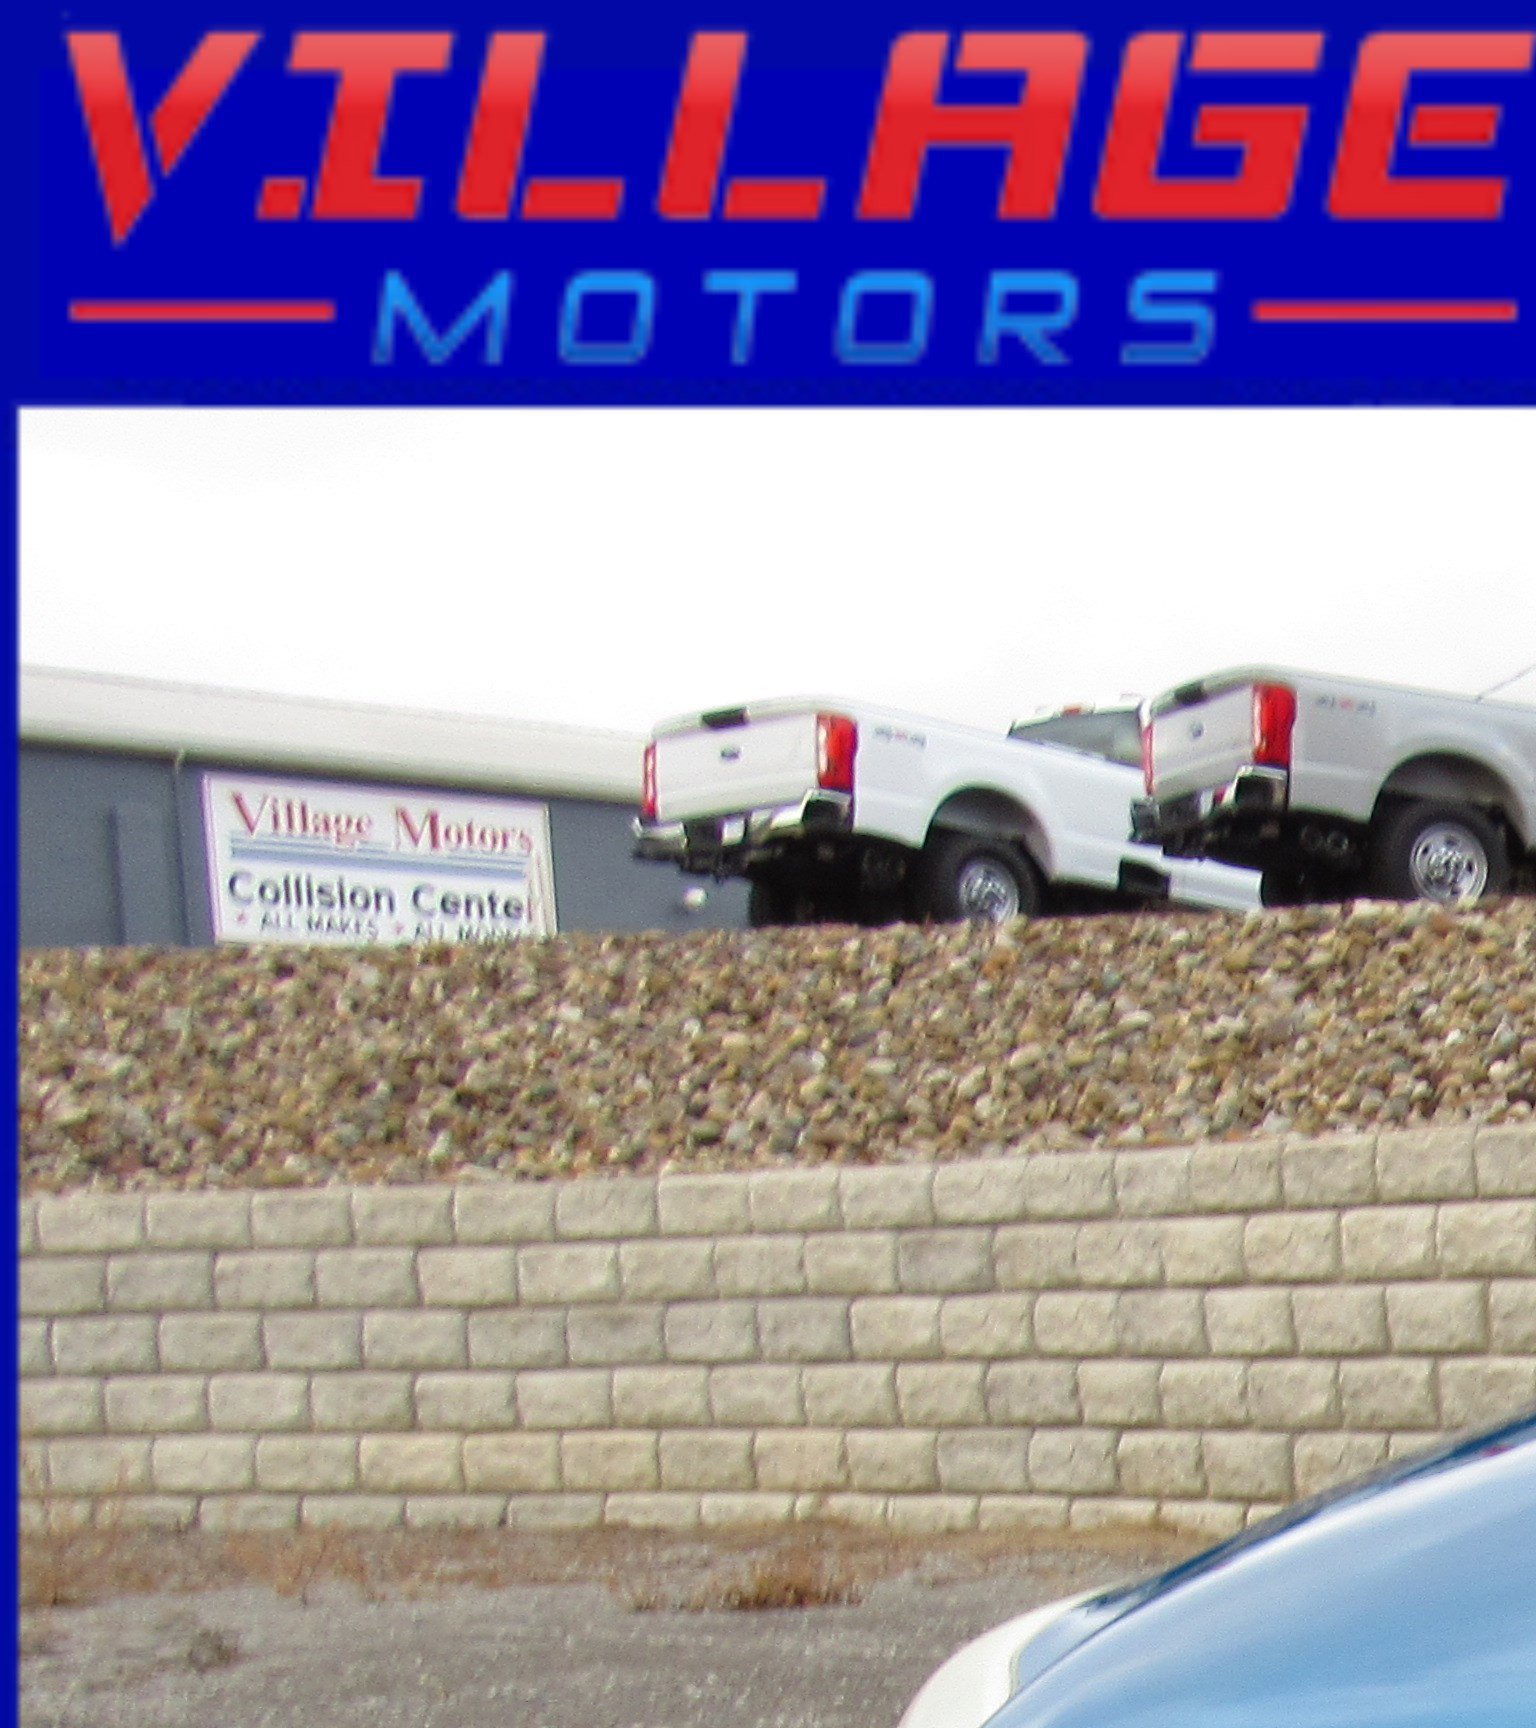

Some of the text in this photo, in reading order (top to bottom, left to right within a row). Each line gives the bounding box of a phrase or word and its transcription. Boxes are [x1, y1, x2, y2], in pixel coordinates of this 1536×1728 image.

[231, 791, 534, 853] Village Motors
[228, 871, 533, 922] Collision Center
